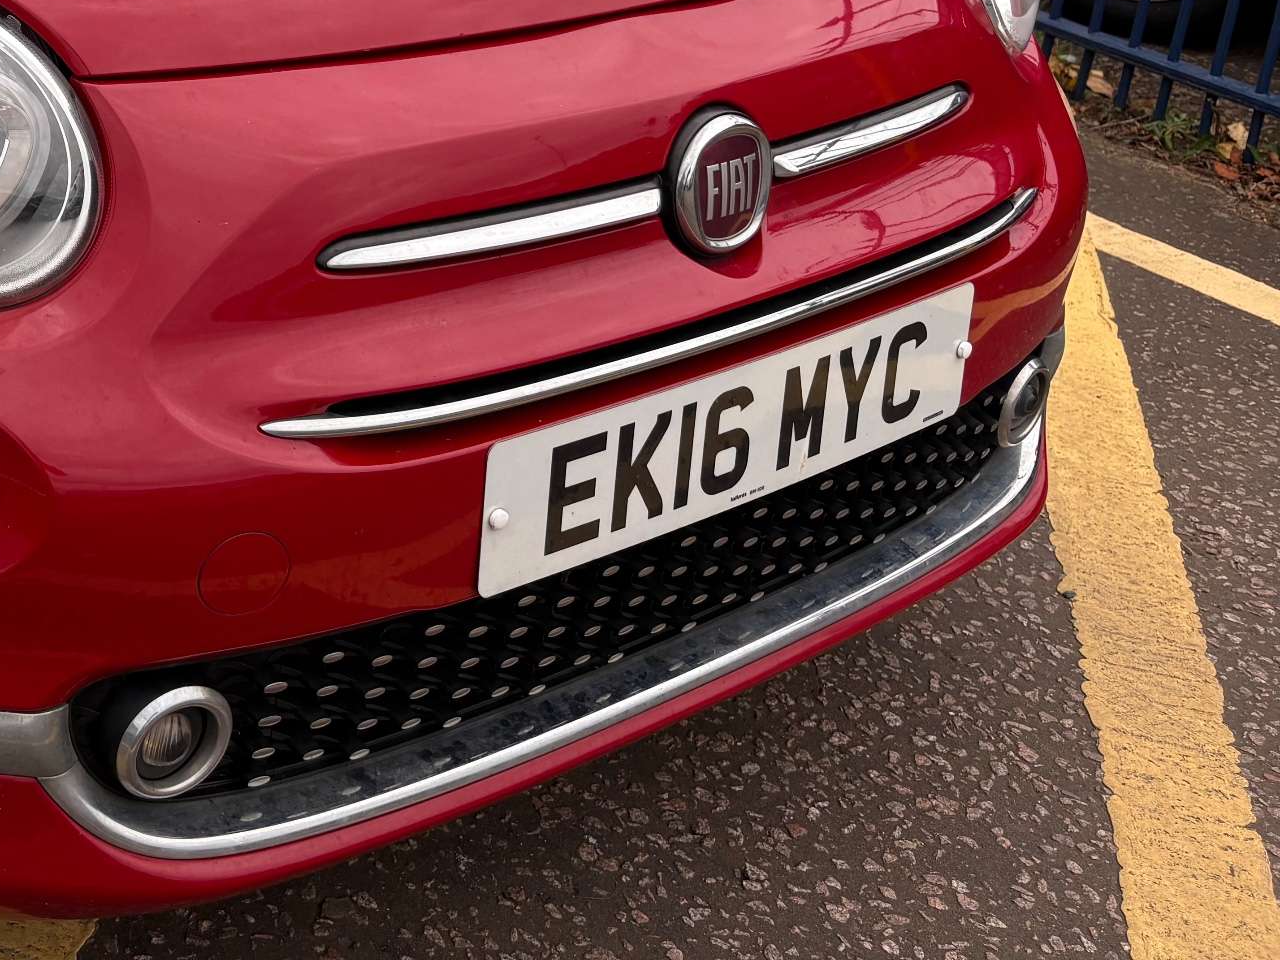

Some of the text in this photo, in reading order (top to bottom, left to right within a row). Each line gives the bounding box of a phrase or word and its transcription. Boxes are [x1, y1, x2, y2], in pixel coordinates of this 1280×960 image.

[706, 152, 756, 221] FIAT
[544, 321, 928, 556] EK16 MYC
